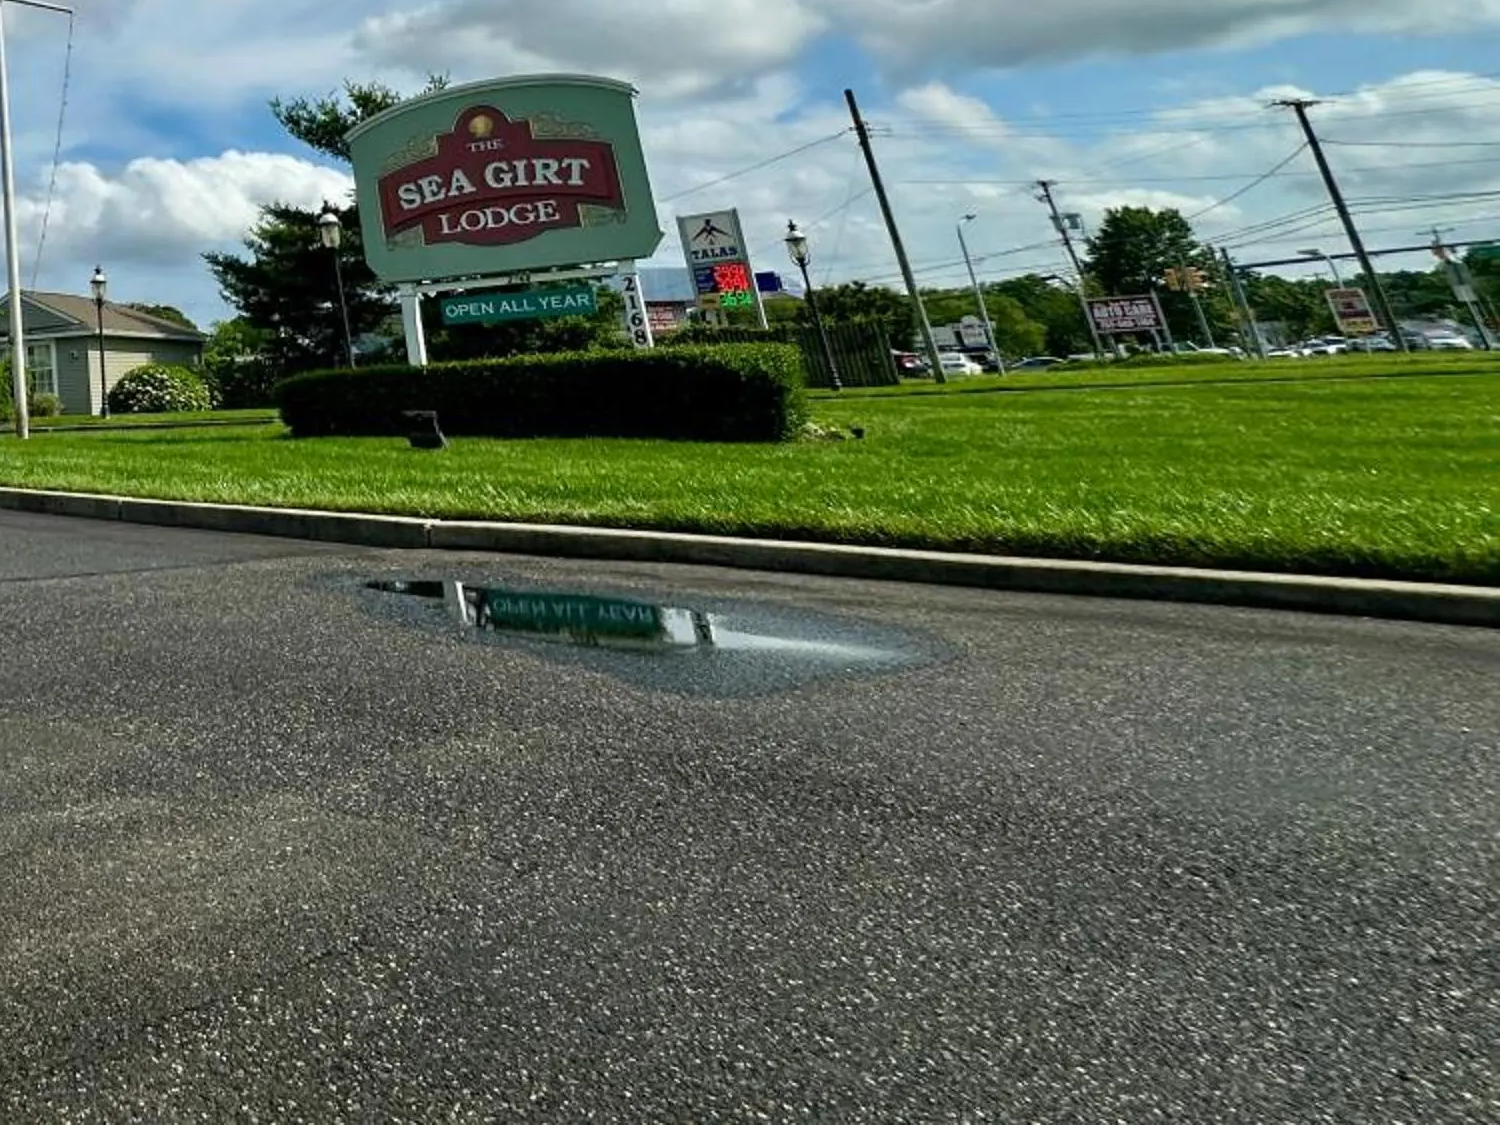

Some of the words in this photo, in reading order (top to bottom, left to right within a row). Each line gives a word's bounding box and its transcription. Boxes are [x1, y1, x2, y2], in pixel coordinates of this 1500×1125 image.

[466, 138, 505, 153] THE
[397, 168, 477, 211] SEA
[484, 158, 591, 189] GIRT
[438, 200, 561, 235] LODGE
[691, 246, 738, 260] TALAS
[445, 301, 494, 318] OPEN
[500, 298, 537, 314] ALL
[539, 293, 590, 310] YEAR
[621, 276, 648, 346] 2168
